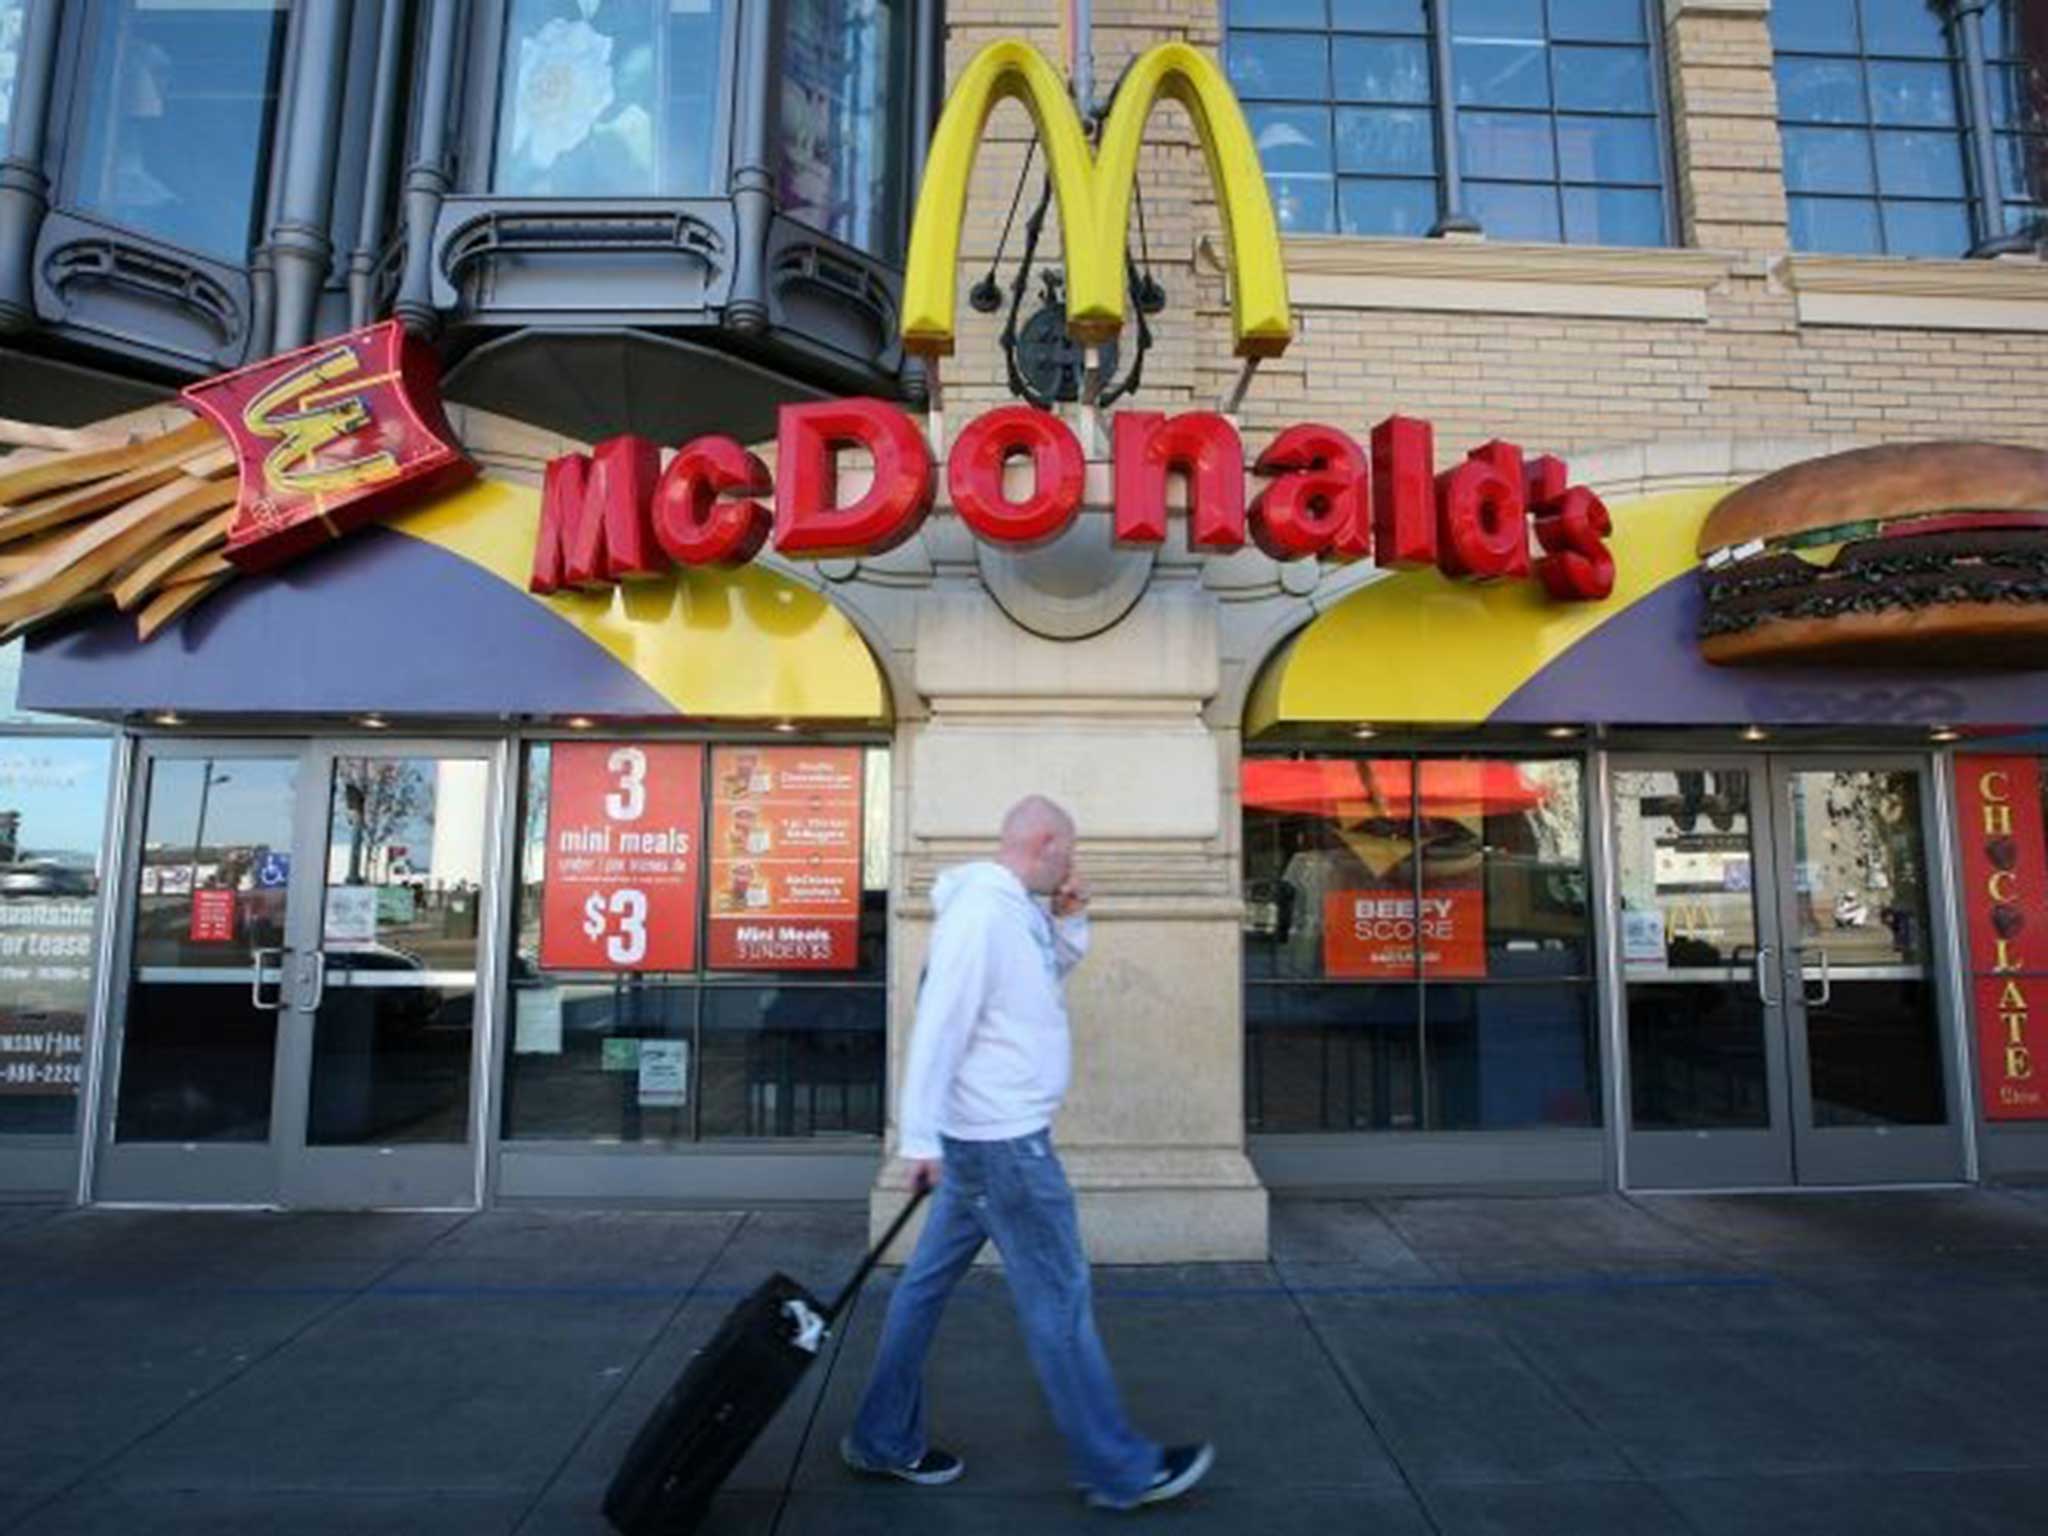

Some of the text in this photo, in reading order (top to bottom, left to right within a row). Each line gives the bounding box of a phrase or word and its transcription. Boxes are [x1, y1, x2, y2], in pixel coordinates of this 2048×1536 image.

[530, 398, 1616, 601] McDonald's
[605, 746, 648, 821] 3
[560, 825, 689, 854] mini meals
[0, 931, 27, 956] or
[582, 888, 648, 963] $3
[1354, 920, 1454, 941] SCORE
